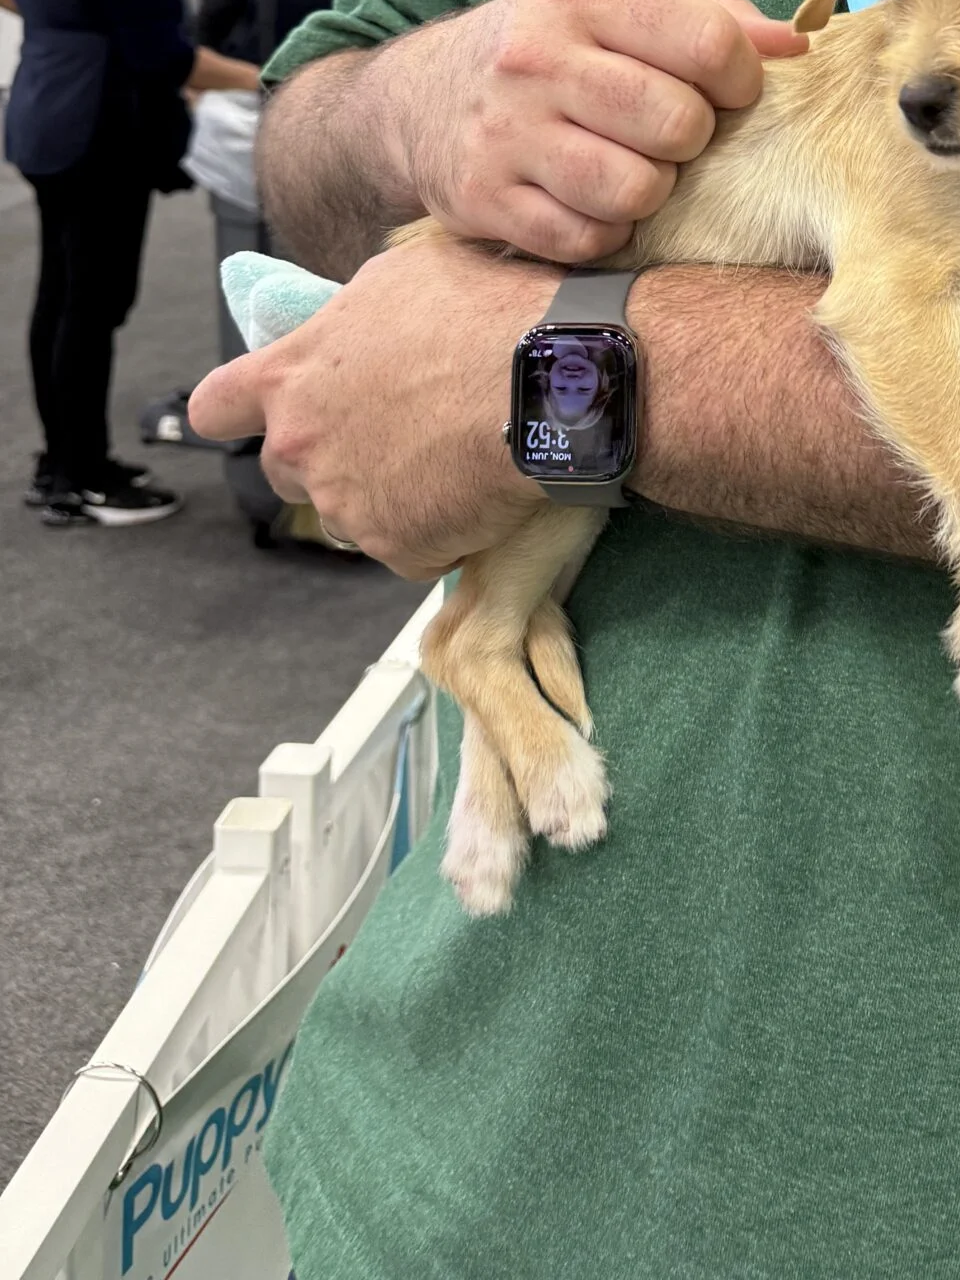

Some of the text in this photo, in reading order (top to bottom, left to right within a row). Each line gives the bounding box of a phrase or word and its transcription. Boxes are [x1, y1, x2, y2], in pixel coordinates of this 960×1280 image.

[531, 452, 550, 461] JUN
[550, 451, 571, 461] MON,
[121, 1036, 297, 1277] Puppy
[162, 1168, 236, 1268] ultimate
